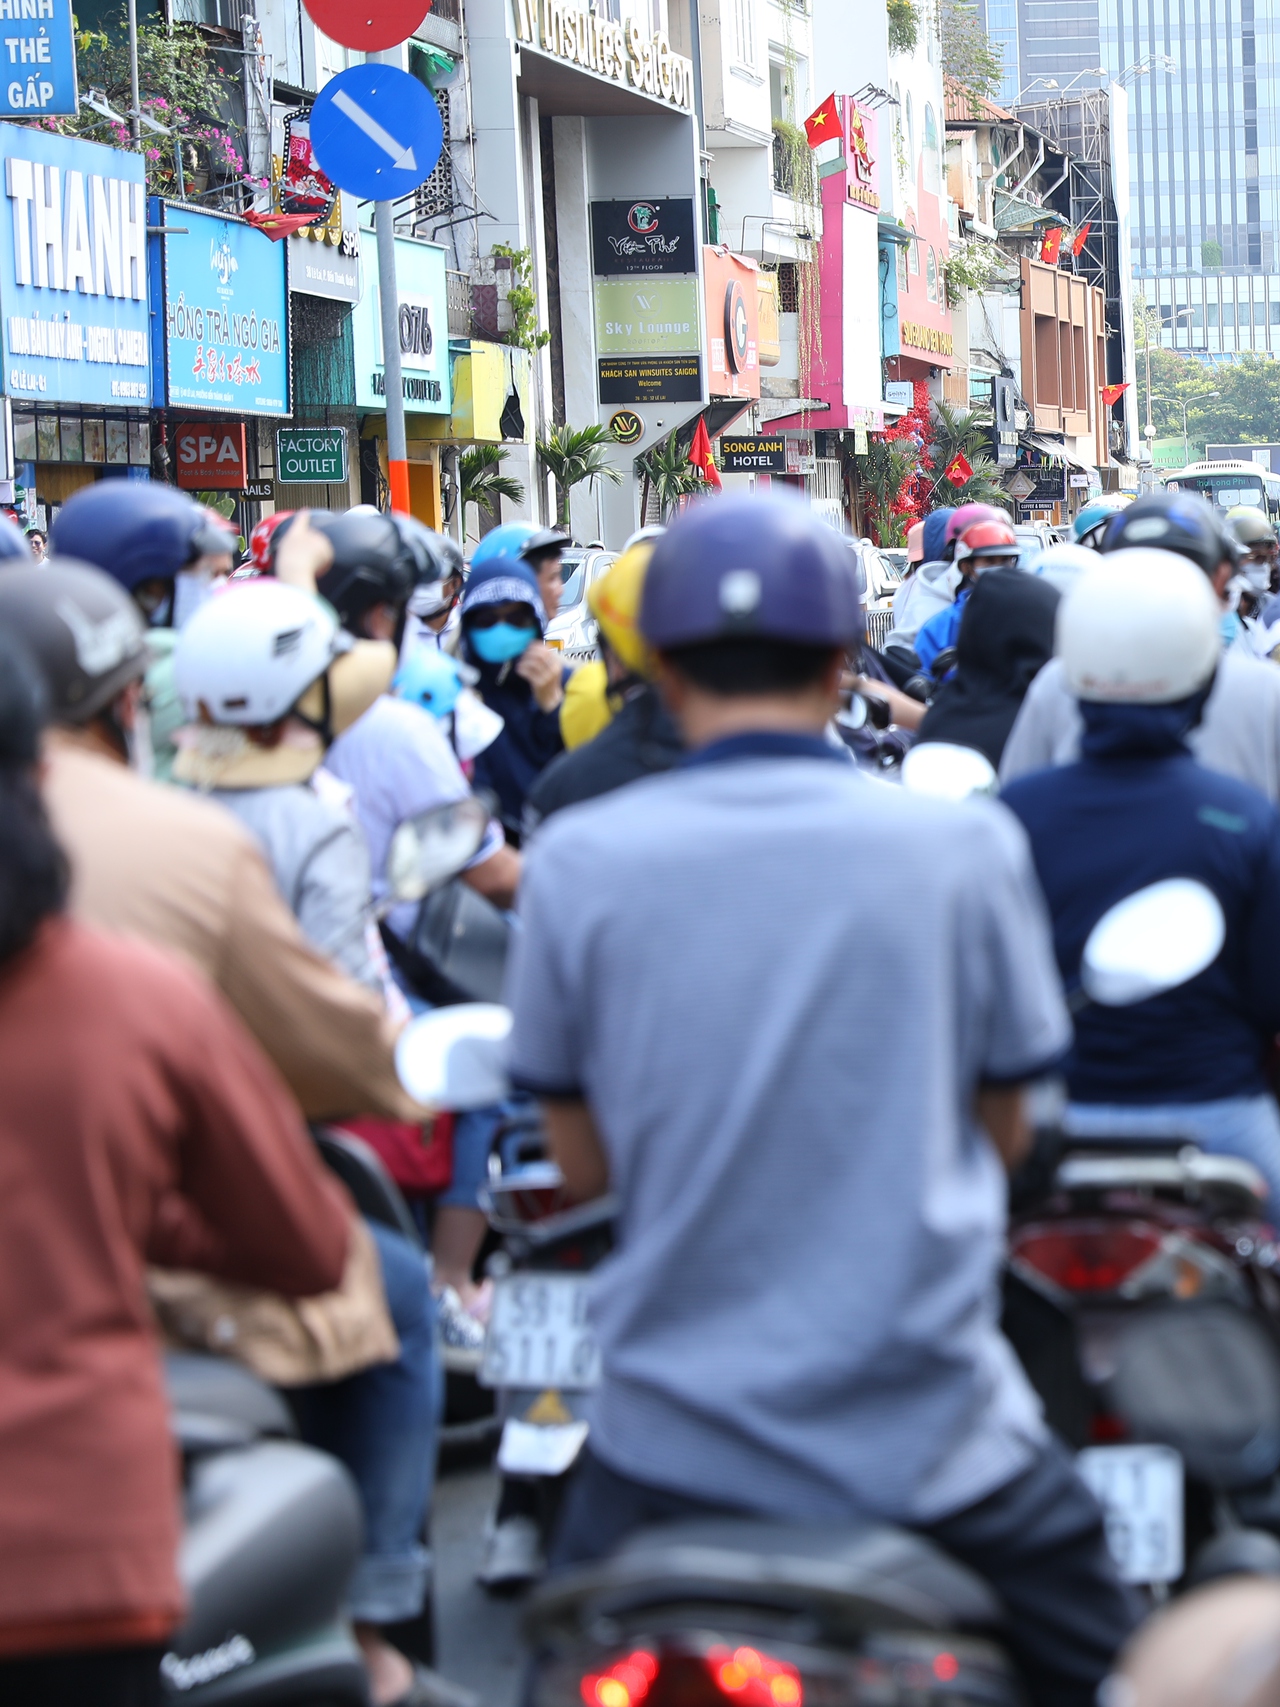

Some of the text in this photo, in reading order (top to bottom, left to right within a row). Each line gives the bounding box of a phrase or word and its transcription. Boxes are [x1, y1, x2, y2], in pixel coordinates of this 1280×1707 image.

[4, 26, 52, 64] THẺ
[7, 72, 54, 109] GẤP
[5, 157, 147, 301] THANH
[167, 291, 280, 353] HỒNG TRÀ NGÔ GIA
[605, 321, 691, 336] Sky Lounge
[600, 367, 698, 379] KHÁCH SẠN WINSUITES SAIGON
[179, 435, 240, 464] SPA
[279, 438, 340, 453] FACTORY
[723, 442, 783, 453] SONG ANH
[285, 458, 337, 474] OUTLET
[733, 455, 774, 466] HOTEL
[200, 469, 214, 477] Body
[215, 469, 241, 477] Massage
[241, 484, 272, 496] NAILS
